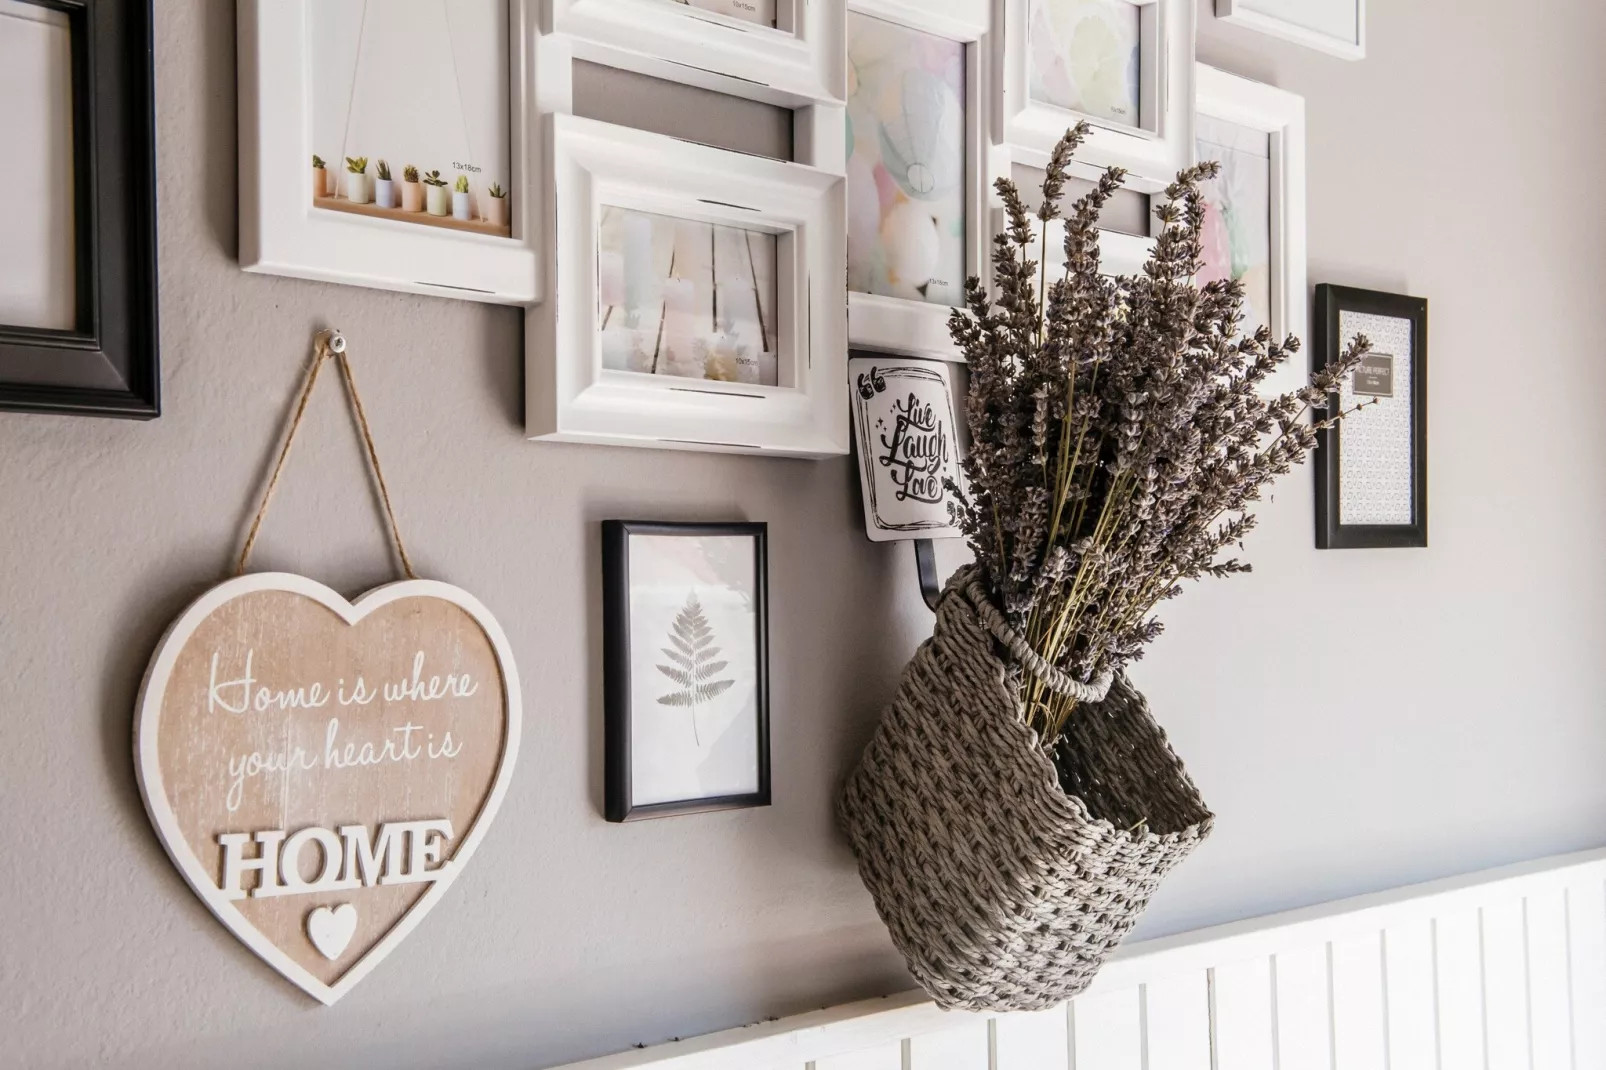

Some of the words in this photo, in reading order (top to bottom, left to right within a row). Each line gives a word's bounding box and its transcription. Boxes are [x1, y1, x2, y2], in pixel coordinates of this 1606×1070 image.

[452, 161, 482, 173] 13x18cm
[896, 392, 936, 432] Live
[879, 420, 949, 475] Laugh
[890, 459, 944, 504] Love
[208, 649, 331, 714] Home
[338, 678, 377, 706] is
[383, 650, 479, 702] where
[226, 746, 318, 811] your
[324, 717, 424, 770] heart
[428, 730, 464, 759] is
[218, 819, 455, 901] HOME
